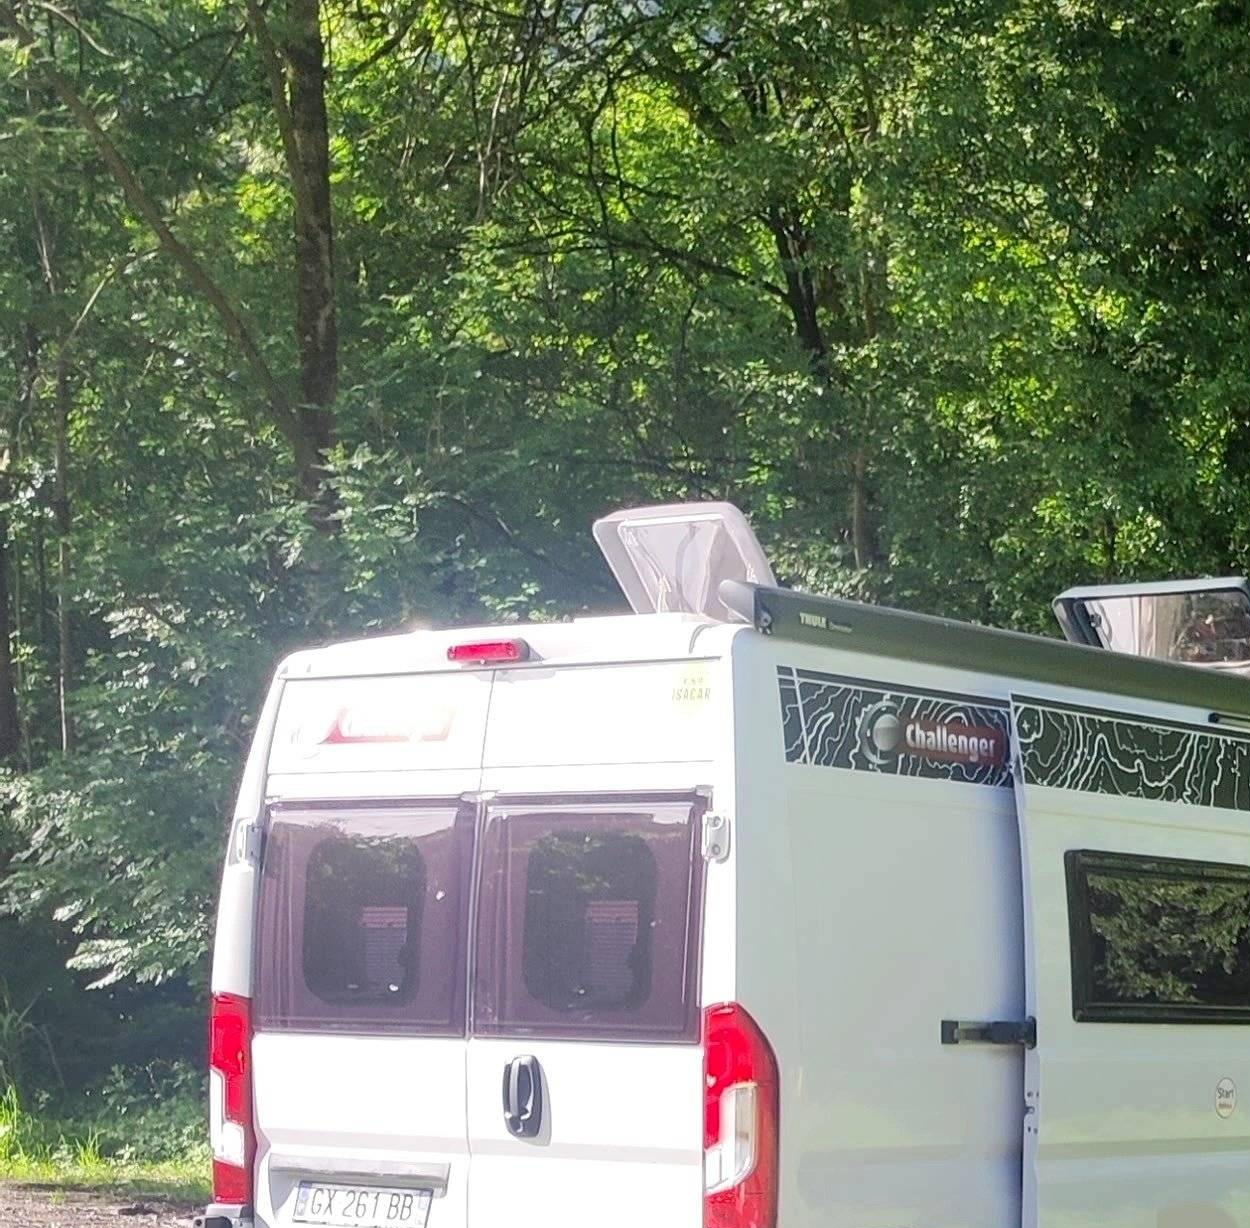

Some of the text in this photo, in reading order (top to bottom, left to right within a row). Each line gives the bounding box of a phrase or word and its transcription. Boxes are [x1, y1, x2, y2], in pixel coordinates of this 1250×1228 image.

[799, 612, 827, 628] THULE
[905, 722, 995, 763] Challenger
[311, 1188, 337, 1216] GX
[342, 1190, 380, 1219] 261
[386, 1193, 414, 1221] BB
